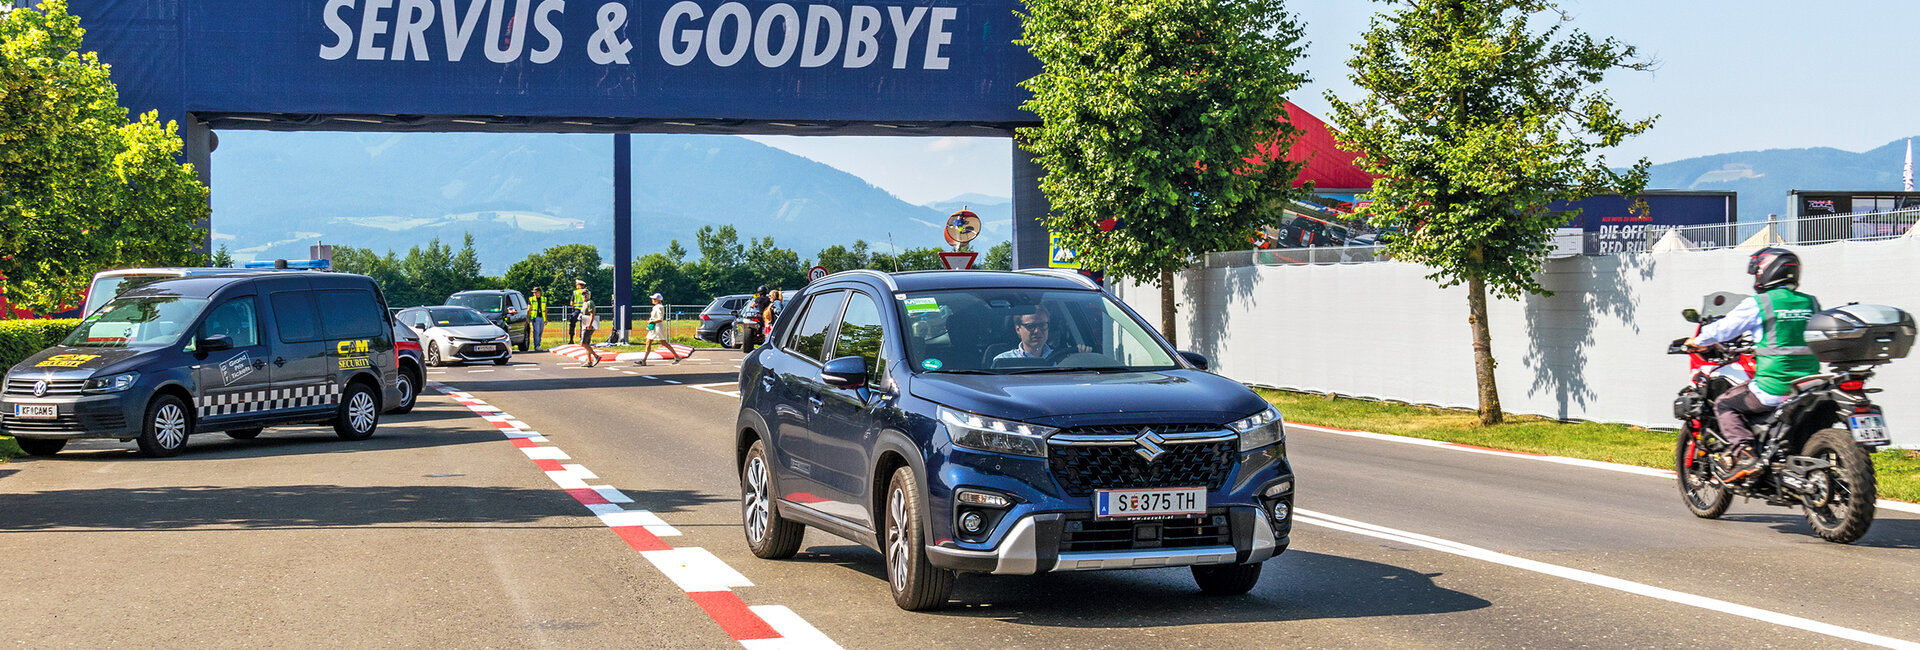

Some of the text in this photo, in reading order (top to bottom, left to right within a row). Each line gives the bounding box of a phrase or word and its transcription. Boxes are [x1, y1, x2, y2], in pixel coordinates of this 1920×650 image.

[319, 0, 958, 70] SERVUS & GOODBYE
[1599, 224, 1618, 239] DIE
[1599, 241, 1623, 255] RED
[814, 270, 825, 280] 30
[337, 340, 369, 354] CAM
[229, 354, 247, 367] Grand
[234, 362, 244, 371] Prix
[339, 358, 370, 368] SECURITY
[231, 366, 251, 379] Tickets
[34, 406, 49, 414] CAM
[49, 406, 53, 414] 5
[1118, 492, 1195, 511] S 375 TH
